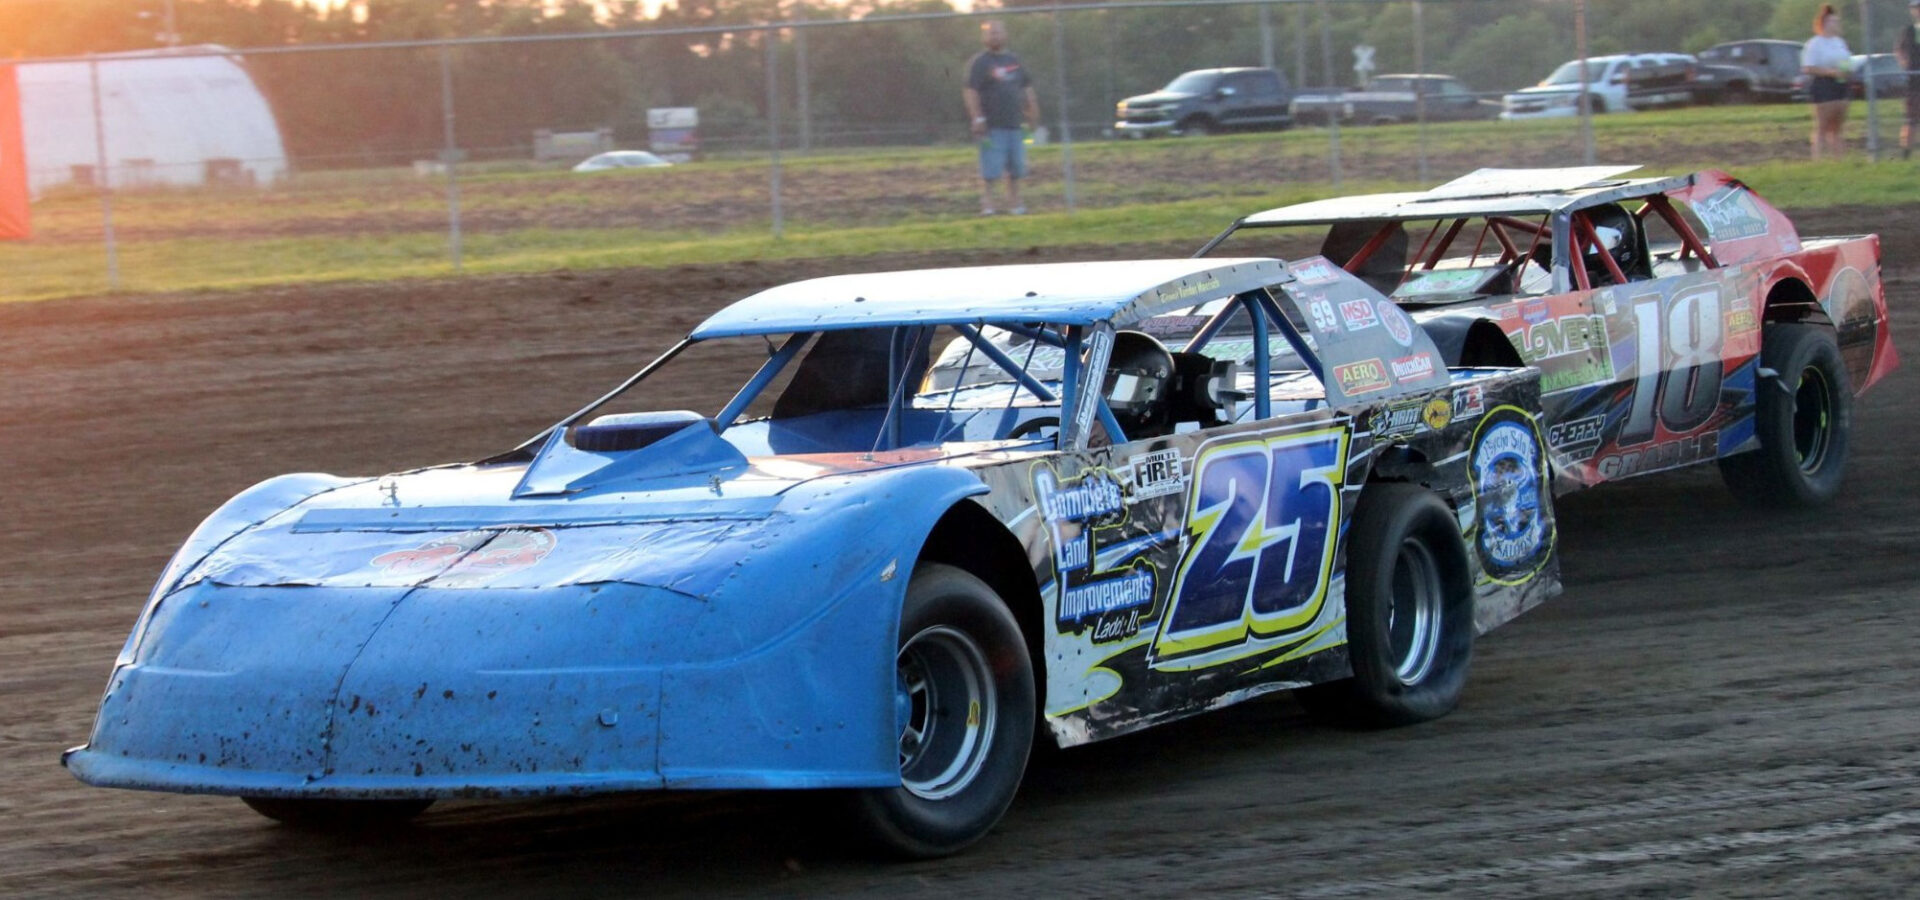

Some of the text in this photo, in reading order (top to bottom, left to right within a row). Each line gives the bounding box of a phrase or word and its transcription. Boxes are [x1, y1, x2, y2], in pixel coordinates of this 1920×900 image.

[1310, 300, 1337, 329] 99
[1341, 301, 1373, 320] MSD
[1343, 363, 1379, 383] AERO
[1618, 284, 1722, 446] 18
[1145, 452, 1175, 463] MULTI
[1135, 459, 1179, 487] FIRE
[1036, 471, 1121, 521] Complete
[1052, 520, 1088, 569] Land
[1162, 436, 1346, 636] 25
[1060, 569, 1152, 620] Improvements
[1126, 610, 1139, 632] IL
